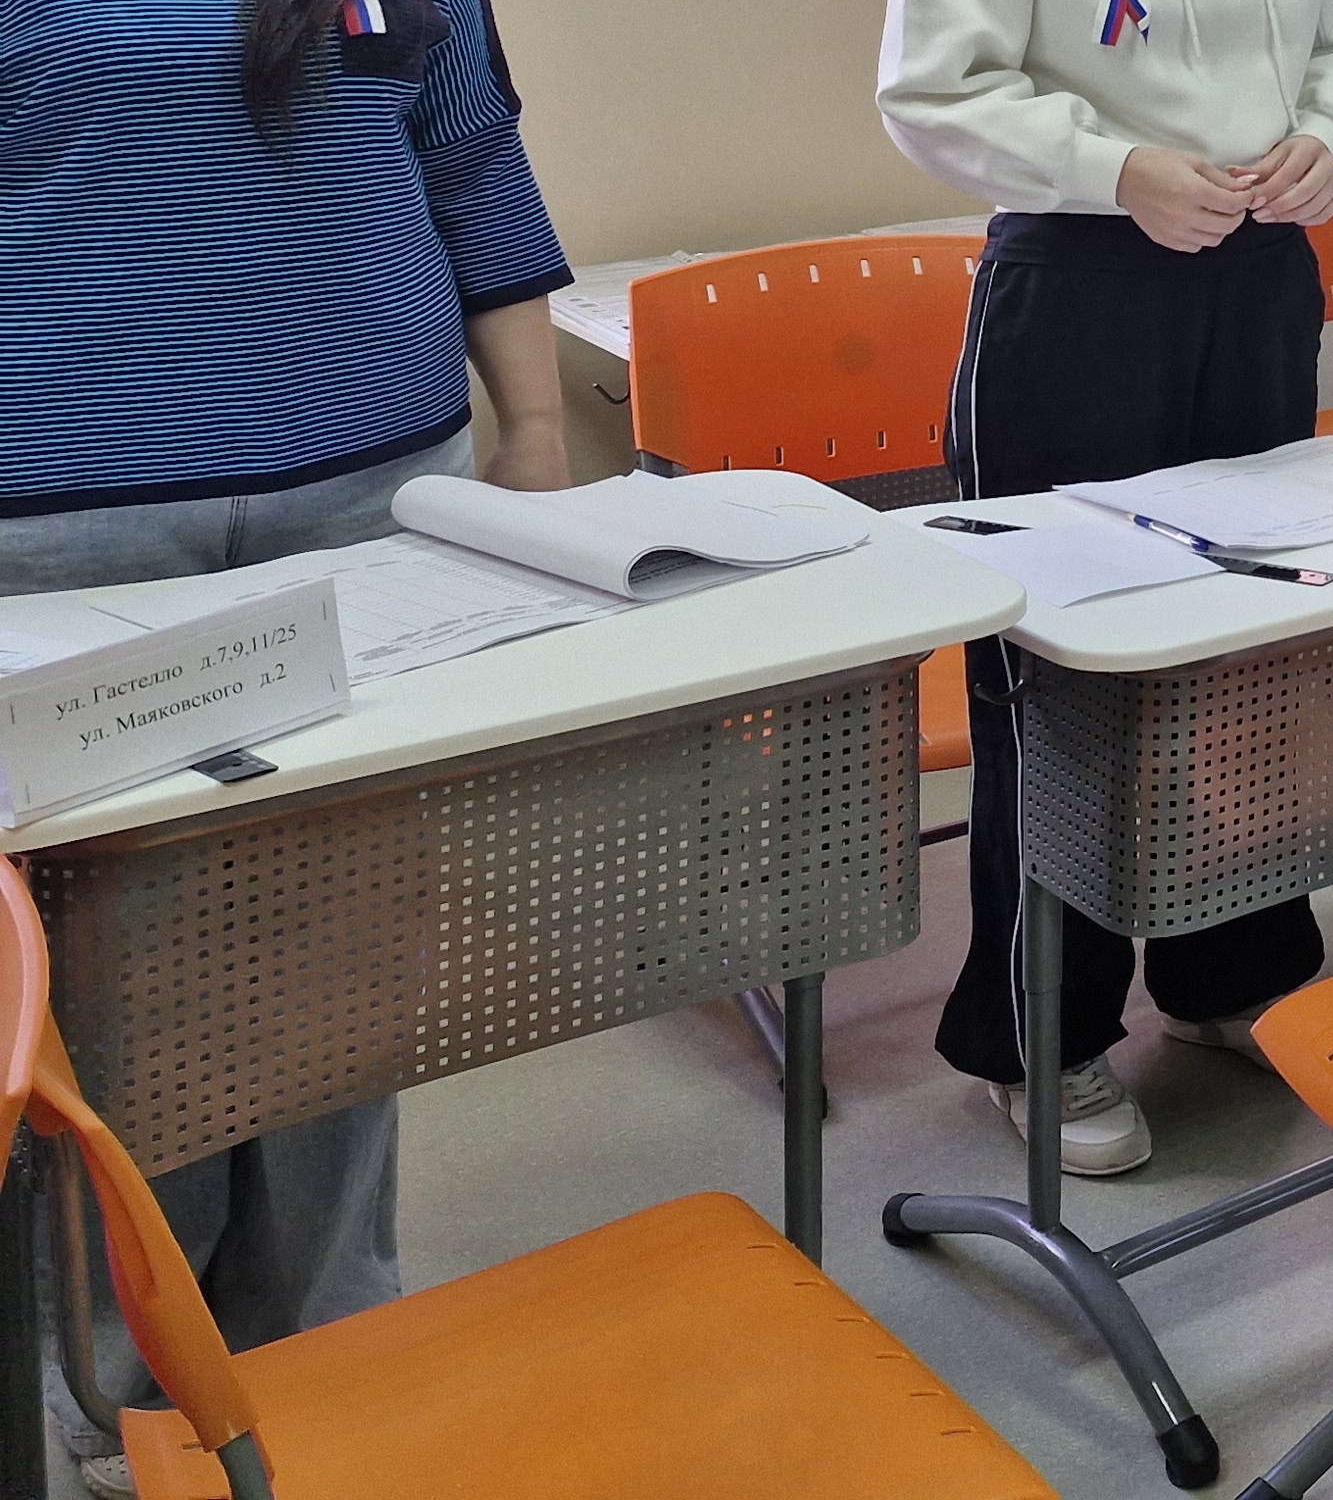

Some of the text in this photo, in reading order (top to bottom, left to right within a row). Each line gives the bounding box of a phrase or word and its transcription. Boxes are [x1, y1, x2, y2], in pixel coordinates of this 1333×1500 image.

[55, 623, 297, 720] ул. Гастелло д.7,9,11/25
[79, 663, 287, 750] ул. Маяковского д.2
